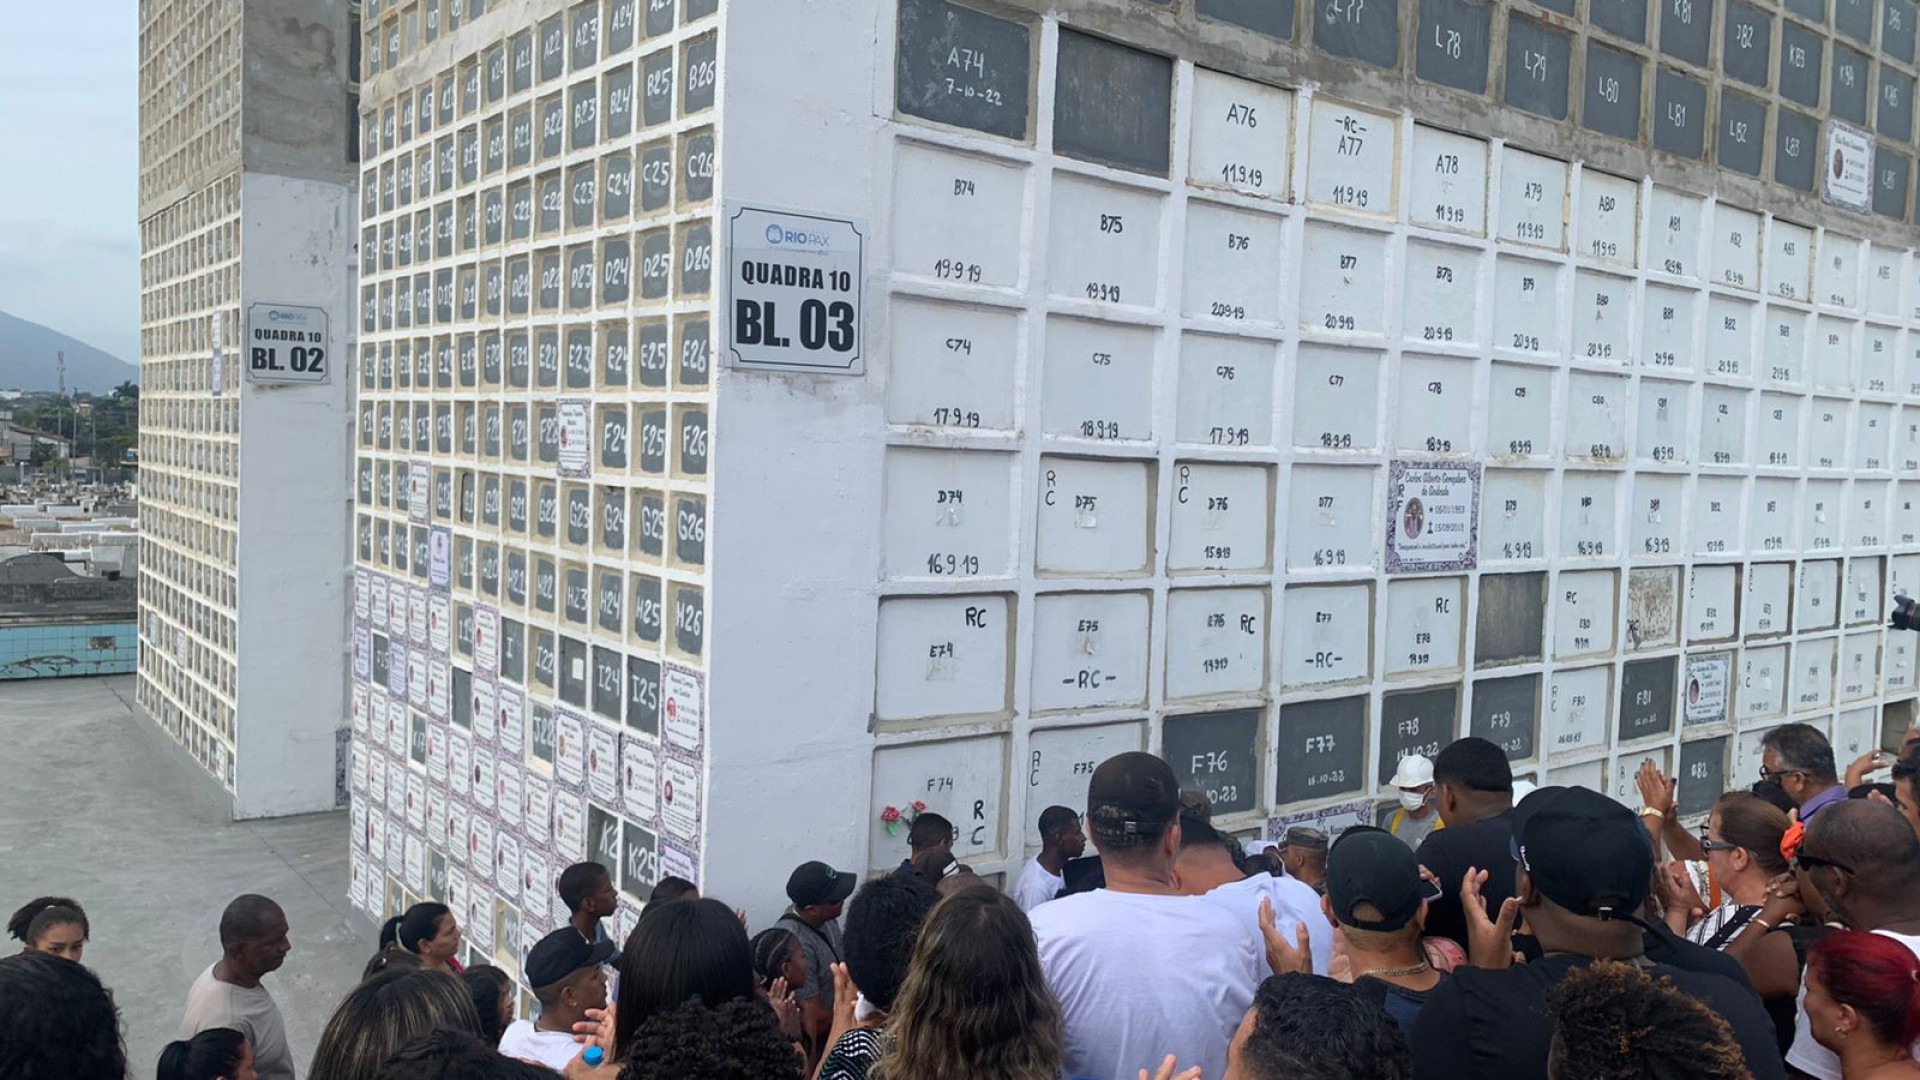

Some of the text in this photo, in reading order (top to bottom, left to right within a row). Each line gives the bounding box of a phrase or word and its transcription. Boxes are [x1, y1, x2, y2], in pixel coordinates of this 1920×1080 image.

[612, 2, 635, 31] A24
[576, 18, 598, 48] A23
[1436, 25, 1461, 59] L78
[1736, 25, 1753, 48] J82
[948, 47, 984, 78] A74
[1525, 50, 1546, 81] L79
[1789, 45, 1805, 68] K83
[648, 68, 672, 96] B25
[690, 61, 715, 91] B26
[611, 84, 631, 115] B24
[1600, 77, 1619, 103] L80
[544, 109, 563, 138] B22
[575, 98, 596, 128] B23
[1226, 103, 1257, 128] A76
[1668, 102, 1686, 126] L81
[515, 123, 529, 149] B21
[1730, 120, 1747, 143] L82
[1338, 136, 1363, 156] A77
[642, 161, 669, 186] C25
[688, 152, 714, 177] C26
[1436, 155, 1459, 174] A78
[574, 178, 594, 206] C23
[608, 170, 631, 196] C24
[954, 180, 974, 196] B74
[1525, 183, 1542, 201] A79
[513, 201, 530, 221] C21
[542, 189, 562, 211] C22
[1599, 196, 1615, 211] A80
[1100, 214, 1122, 233] B75
[1228, 235, 1249, 250] B76
[644, 253, 670, 277] D25
[685, 245, 710, 271] D26
[1340, 255, 1356, 269] B77
[542, 268, 560, 289] D22
[571, 264, 592, 288] D23
[605, 258, 628, 284] D24
[742, 261, 850, 292] QUADRA 10
[1436, 266, 1452, 282] B78
[512, 274, 528, 298] D21
[1523, 278, 1534, 291] B79
[1596, 294, 1608, 306] B80
[255, 329, 321, 342] QUADRA 10
[736, 299, 853, 352] BL. 03
[512, 346, 528, 367] E21
[539, 342, 557, 369] E22
[569, 344, 591, 373] E23
[608, 344, 628, 372] E24
[642, 343, 667, 369] E25
[683, 340, 707, 373] E26
[947, 338, 971, 355] C74
[252, 347, 324, 372] BL. 02
[1093, 353, 1110, 366] C75
[1217, 366, 1234, 380] C76
[1329, 375, 1343, 387] C77
[1428, 382, 1442, 394] C78
[1592, 396, 1604, 405] C80
[512, 420, 527, 445] F21
[605, 422, 628, 452] F24
[642, 422, 666, 456] F25
[683, 423, 706, 457] F26
[938, 490, 962, 502] D74
[1075, 496, 1096, 509] D75
[1208, 498, 1228, 510] D76
[1319, 497, 1333, 508] D77
[511, 497, 525, 520] G21
[539, 497, 556, 522] G22
[570, 500, 589, 528] G23
[604, 504, 626, 532] G24
[642, 506, 664, 540] G25
[678, 510, 704, 542] G26
[568, 586, 588, 611] H23
[600, 588, 621, 620] H24
[1435, 598, 1450, 613] RC
[636, 596, 660, 626] H25
[676, 601, 702, 636] H26
[965, 607, 987, 628] RC
[1078, 620, 1098, 632] E75
[1241, 615, 1255, 634] RC
[1416, 633, 1430, 643] E78
[930, 643, 953, 658] E74
[598, 665, 621, 696] I24
[632, 675, 657, 710] I25
[1398, 718, 1419, 735] F78
[1492, 711, 1511, 728] F79
[1306, 735, 1335, 753] F77
[1073, 762, 1094, 774] F75
[1191, 750, 1227, 774] F76
[928, 778, 953, 791] F74
[972, 800, 984, 845] R C
[629, 842, 659, 887] K25
